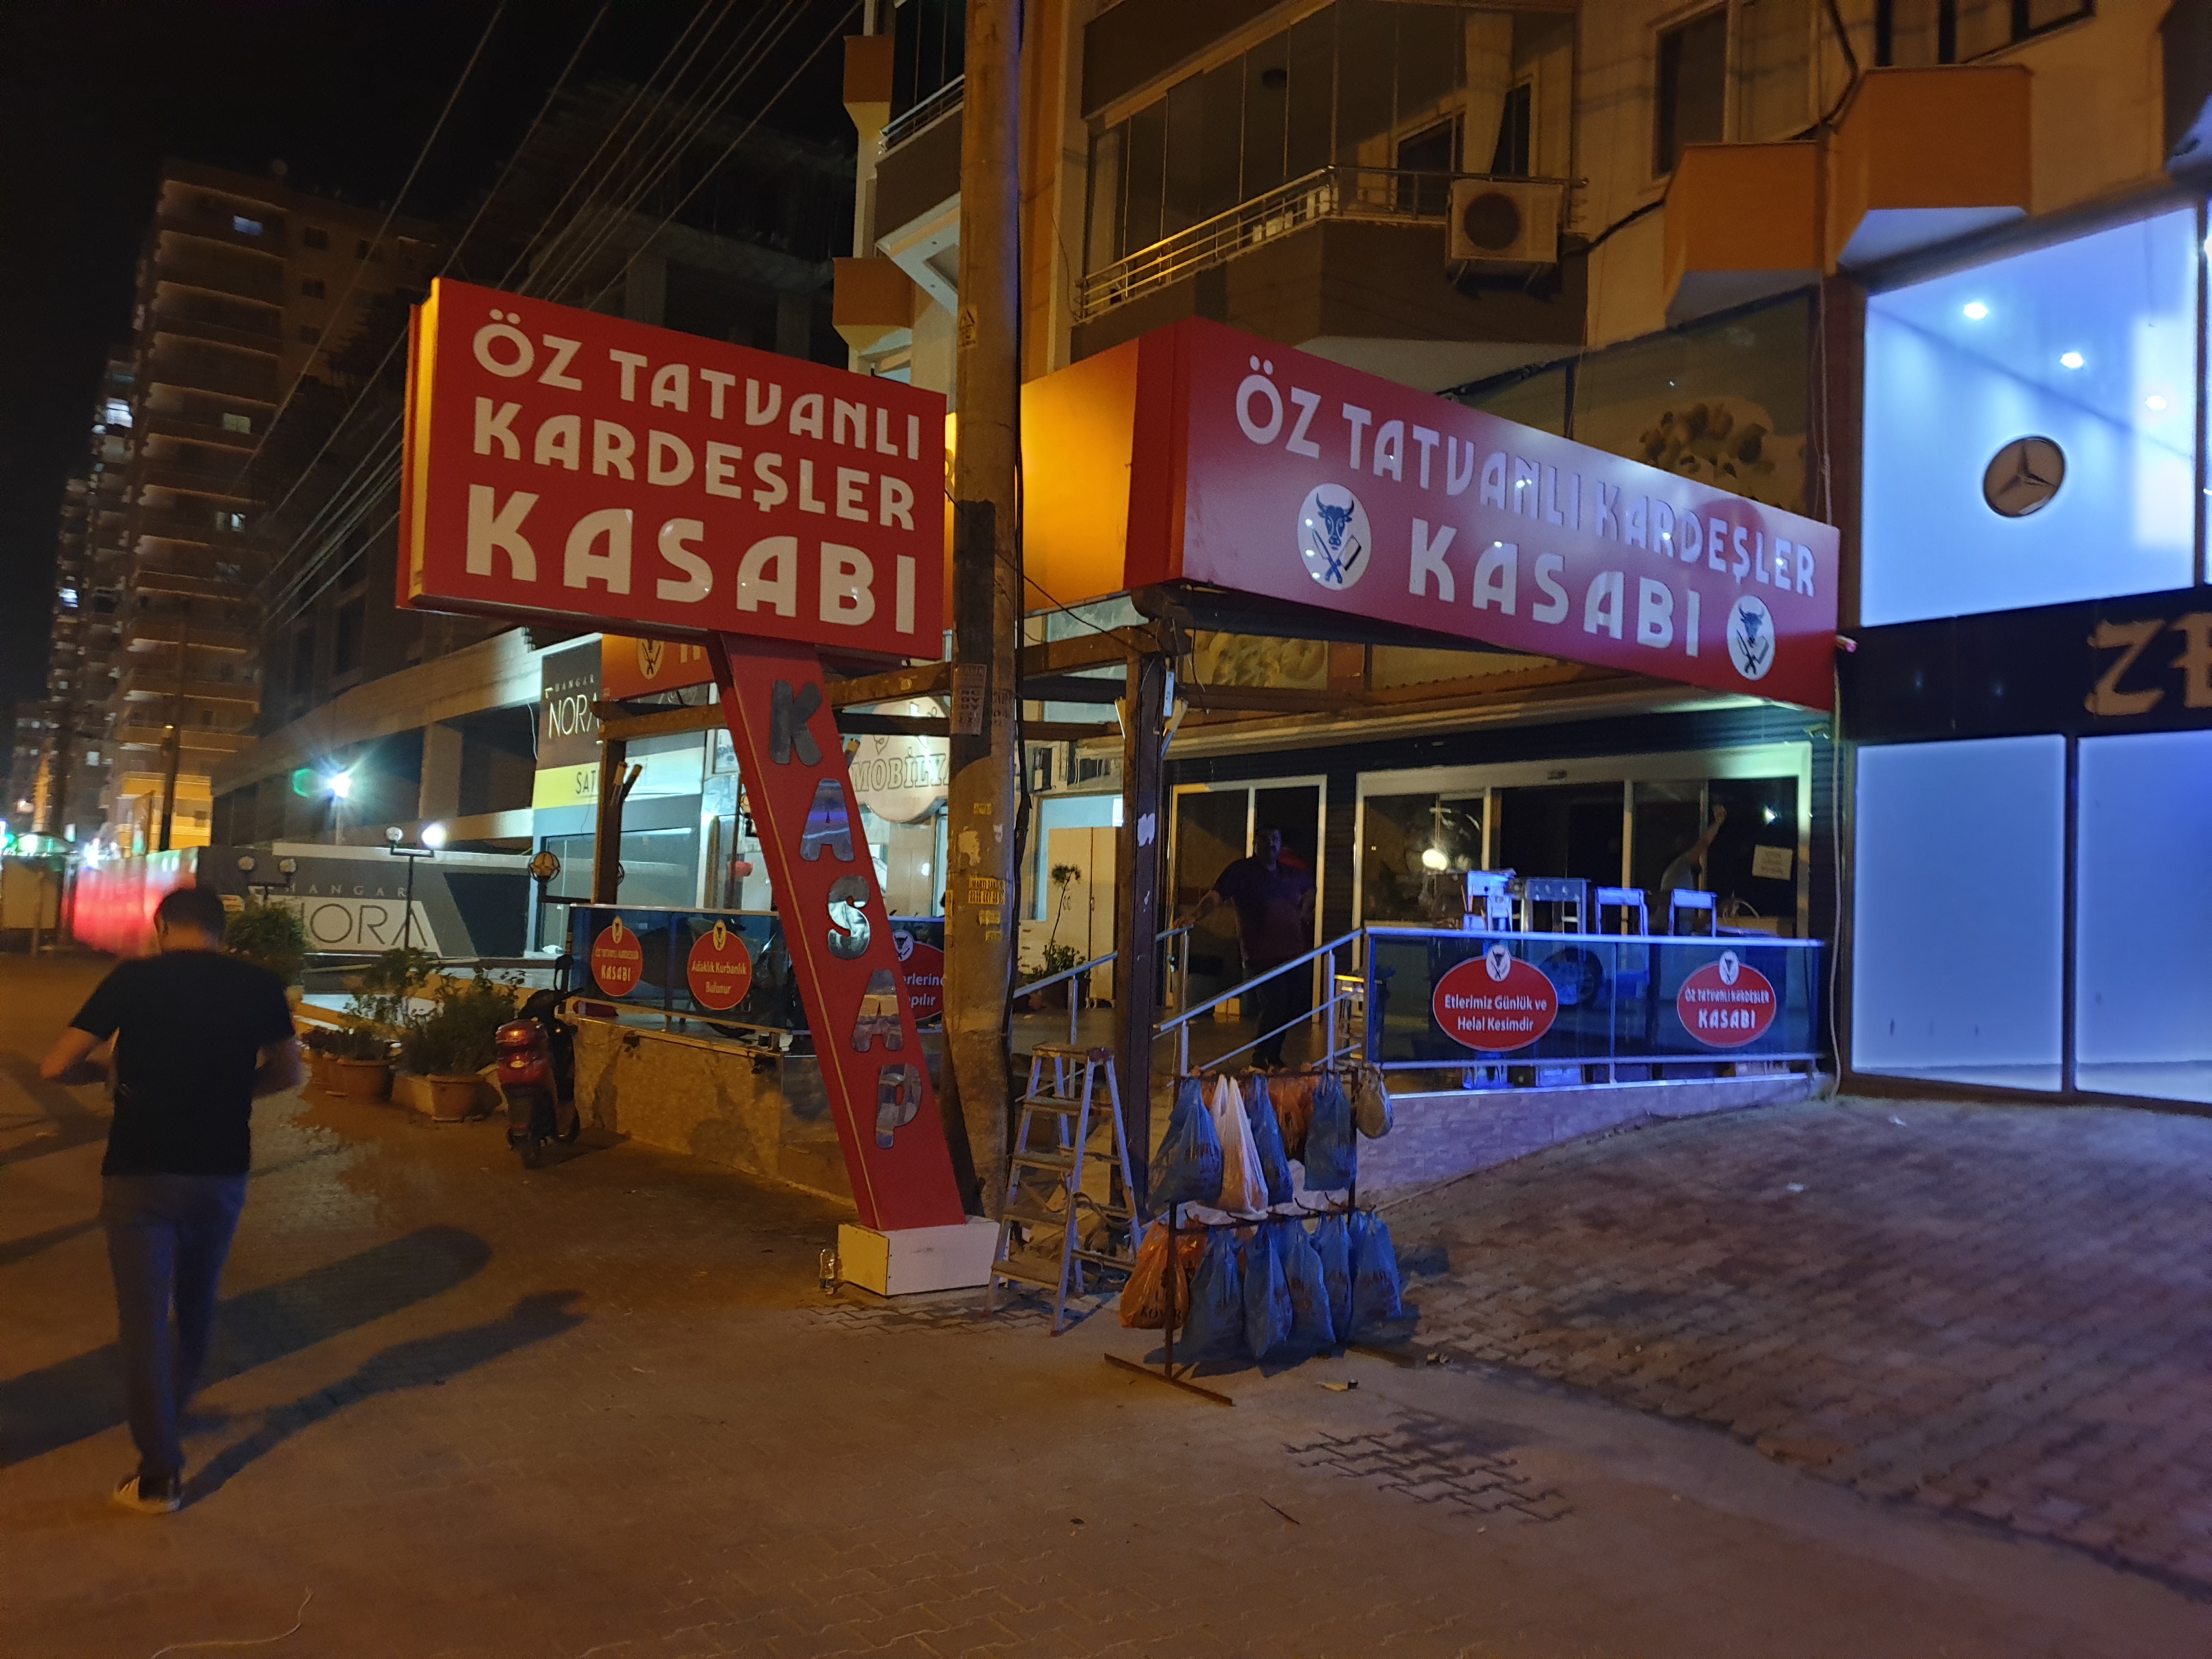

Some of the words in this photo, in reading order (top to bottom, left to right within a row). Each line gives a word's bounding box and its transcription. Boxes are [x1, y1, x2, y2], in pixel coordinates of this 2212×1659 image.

[472, 308, 582, 392] ÖZ
[609, 348, 919, 461] TATVANLI
[473, 396, 915, 531] KARDEŞLER
[1235, 354, 1322, 459] ÖZ
[1342, 402, 1581, 530] TATVANLI
[1595, 479, 1816, 597] KARDEŞLER
[466, 484, 916, 635] KASABI
[1408, 517, 1701, 658] KASABI
[851, 746, 949, 792] MOBİLY
[301, 902, 428, 946] ORA
[770, 679, 923, 1149] KASAP
[904, 973, 944, 986] rlerin
[909, 994, 936, 1008] pılır
[1494, 994, 1533, 1011] Günlük
[1535, 999, 1547, 1011] ve
[1458, 1015, 1485, 1031] Helal
[1699, 1008, 1756, 1029] KASABI
